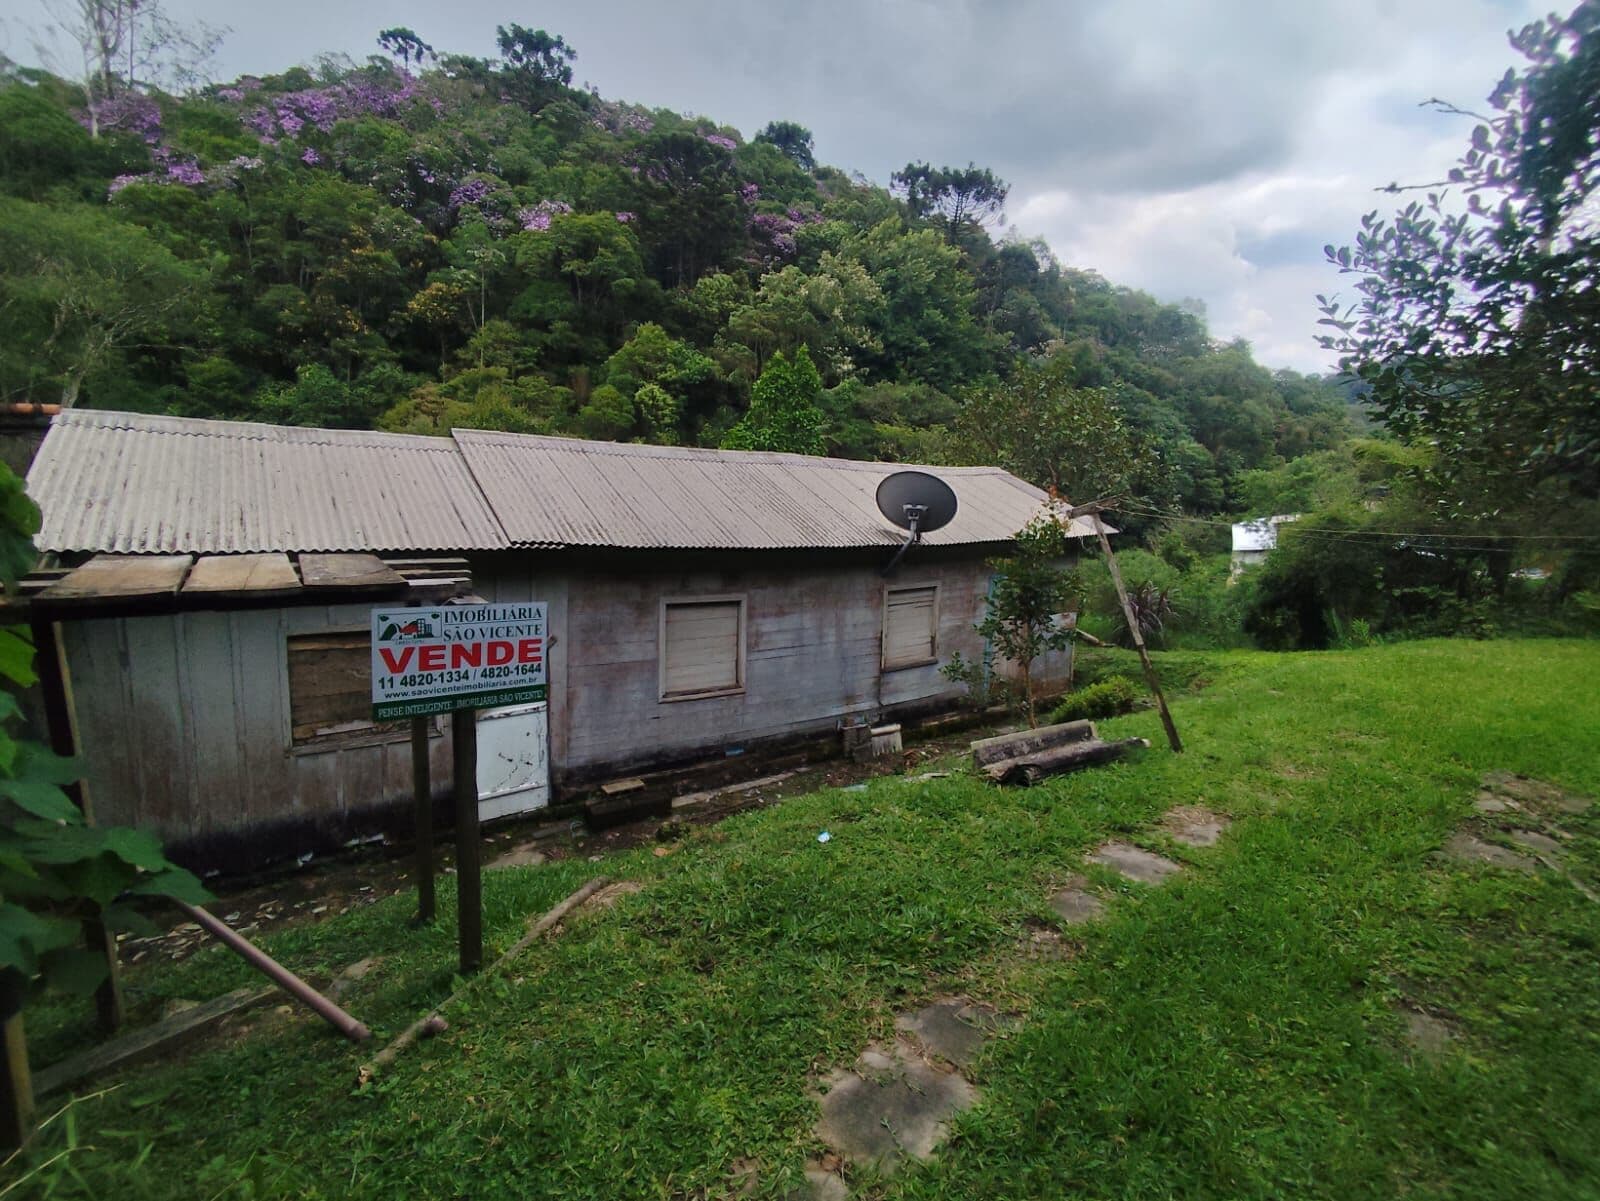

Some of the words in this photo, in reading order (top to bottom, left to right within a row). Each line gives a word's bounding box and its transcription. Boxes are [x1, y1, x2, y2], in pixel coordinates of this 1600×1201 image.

[444, 606, 542, 623] IMOBILIÁRIA
[443, 626, 475, 642] SÃO
[481, 624, 542, 639] VICENTE
[378, 639, 543, 674] VENDE
[378, 677, 394, 689] 11
[400, 669, 469, 687] 4820-1334
[480, 663, 542, 679] 4820-1644
[384, 677, 538, 699] www.saovicenteimobiliaria.com.br
[378, 706, 404, 718] PENSE
